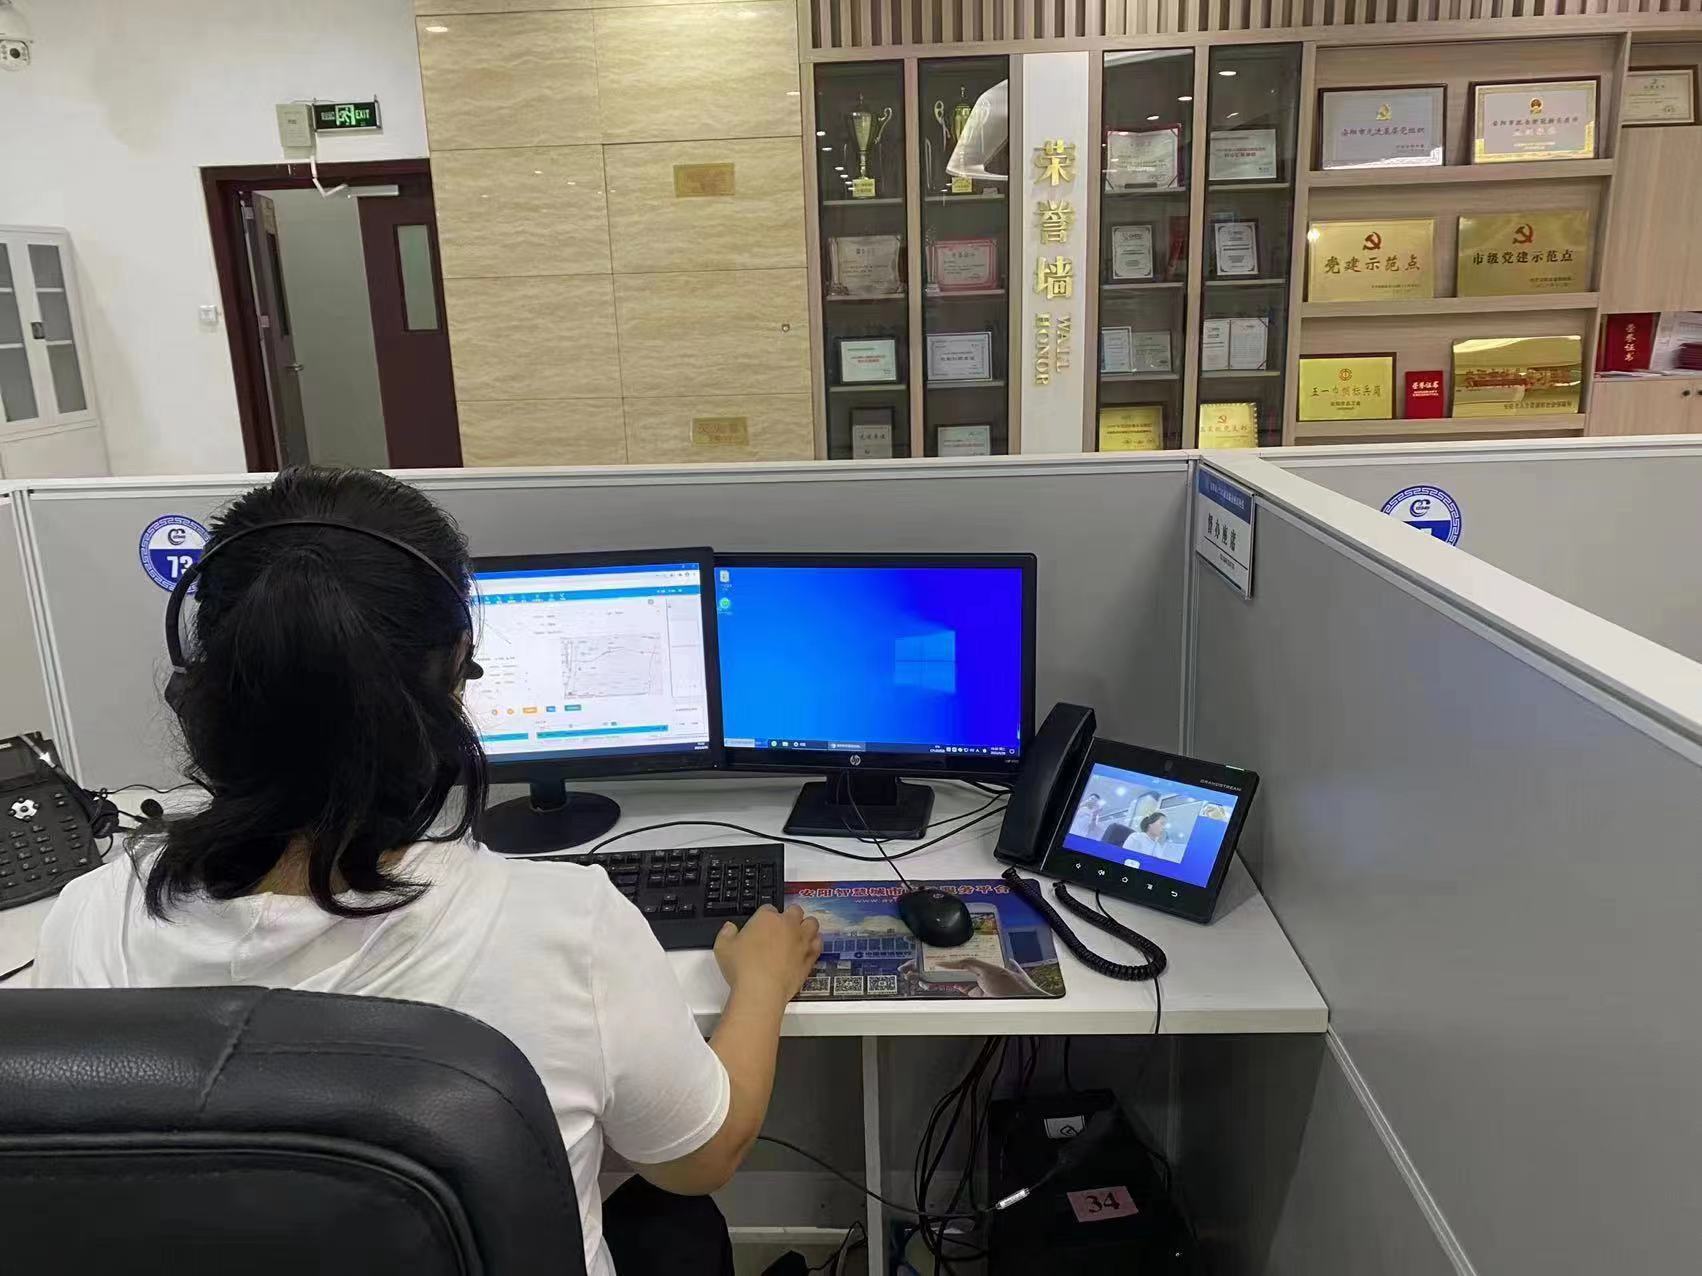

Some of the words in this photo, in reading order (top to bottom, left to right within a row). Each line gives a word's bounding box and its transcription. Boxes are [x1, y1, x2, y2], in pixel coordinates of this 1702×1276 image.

[355, 109, 370, 119] EXIT
[1033, 138, 1076, 300] 荣誉墙
[1324, 254, 1421, 274] 党建示范点
[1472, 249, 1574, 265] 市级党建示范点
[1035, 312, 1051, 385] HONOR
[1200, 779, 1242, 792] GRANDSTREAM
[799, 884, 1010, 898] 安阳智慧城市服务平台
[1085, 1192, 1121, 1214] 34
